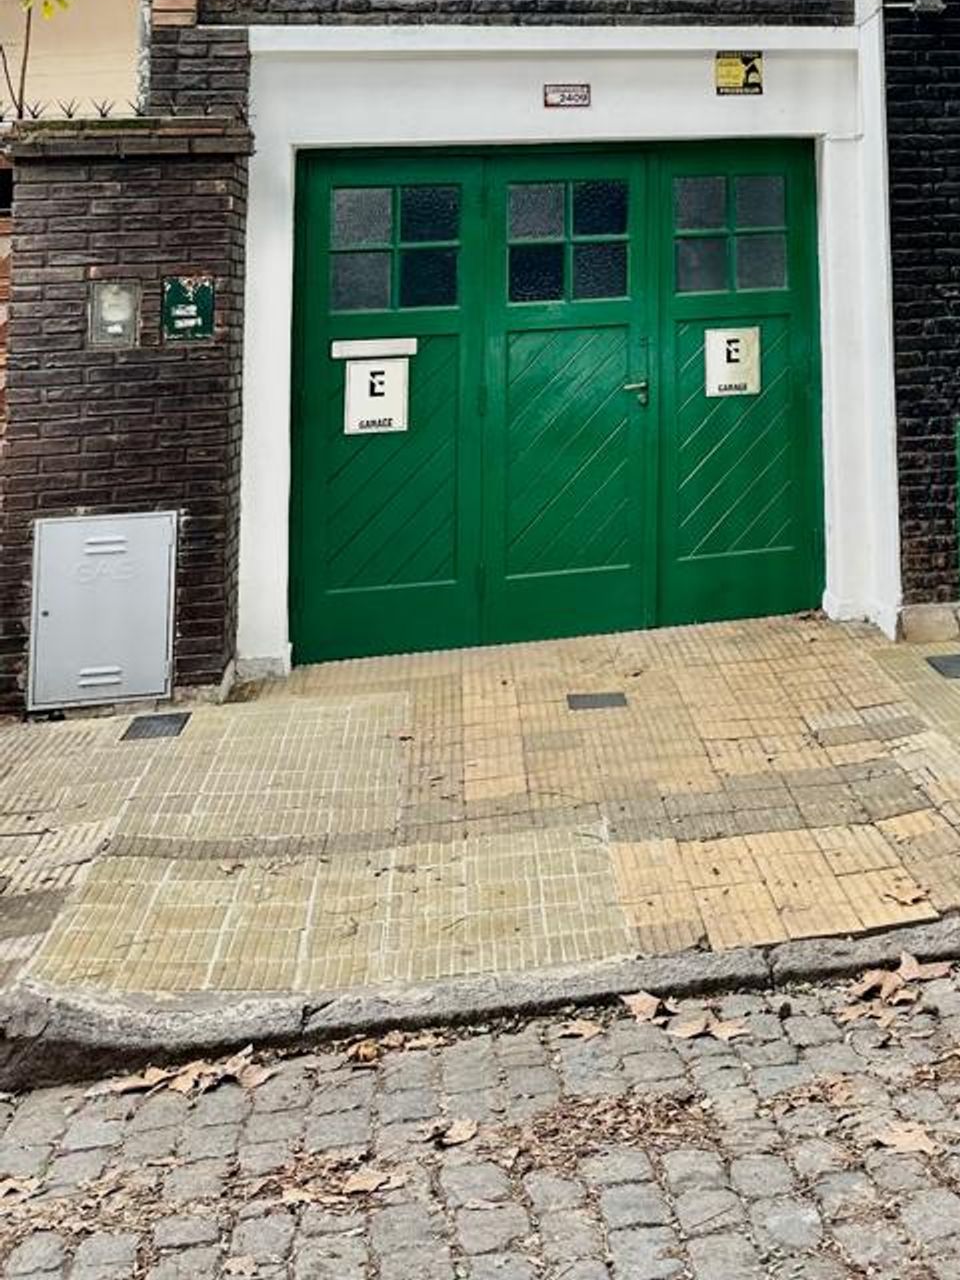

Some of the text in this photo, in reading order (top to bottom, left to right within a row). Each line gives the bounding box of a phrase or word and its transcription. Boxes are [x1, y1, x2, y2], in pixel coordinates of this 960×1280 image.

[560, 94, 588, 103] 2409
[726, 338, 740, 364] E
[369, 370, 385, 397] E
[717, 383, 748, 393] GARAGE
[358, 417, 393, 429] GARAGE
